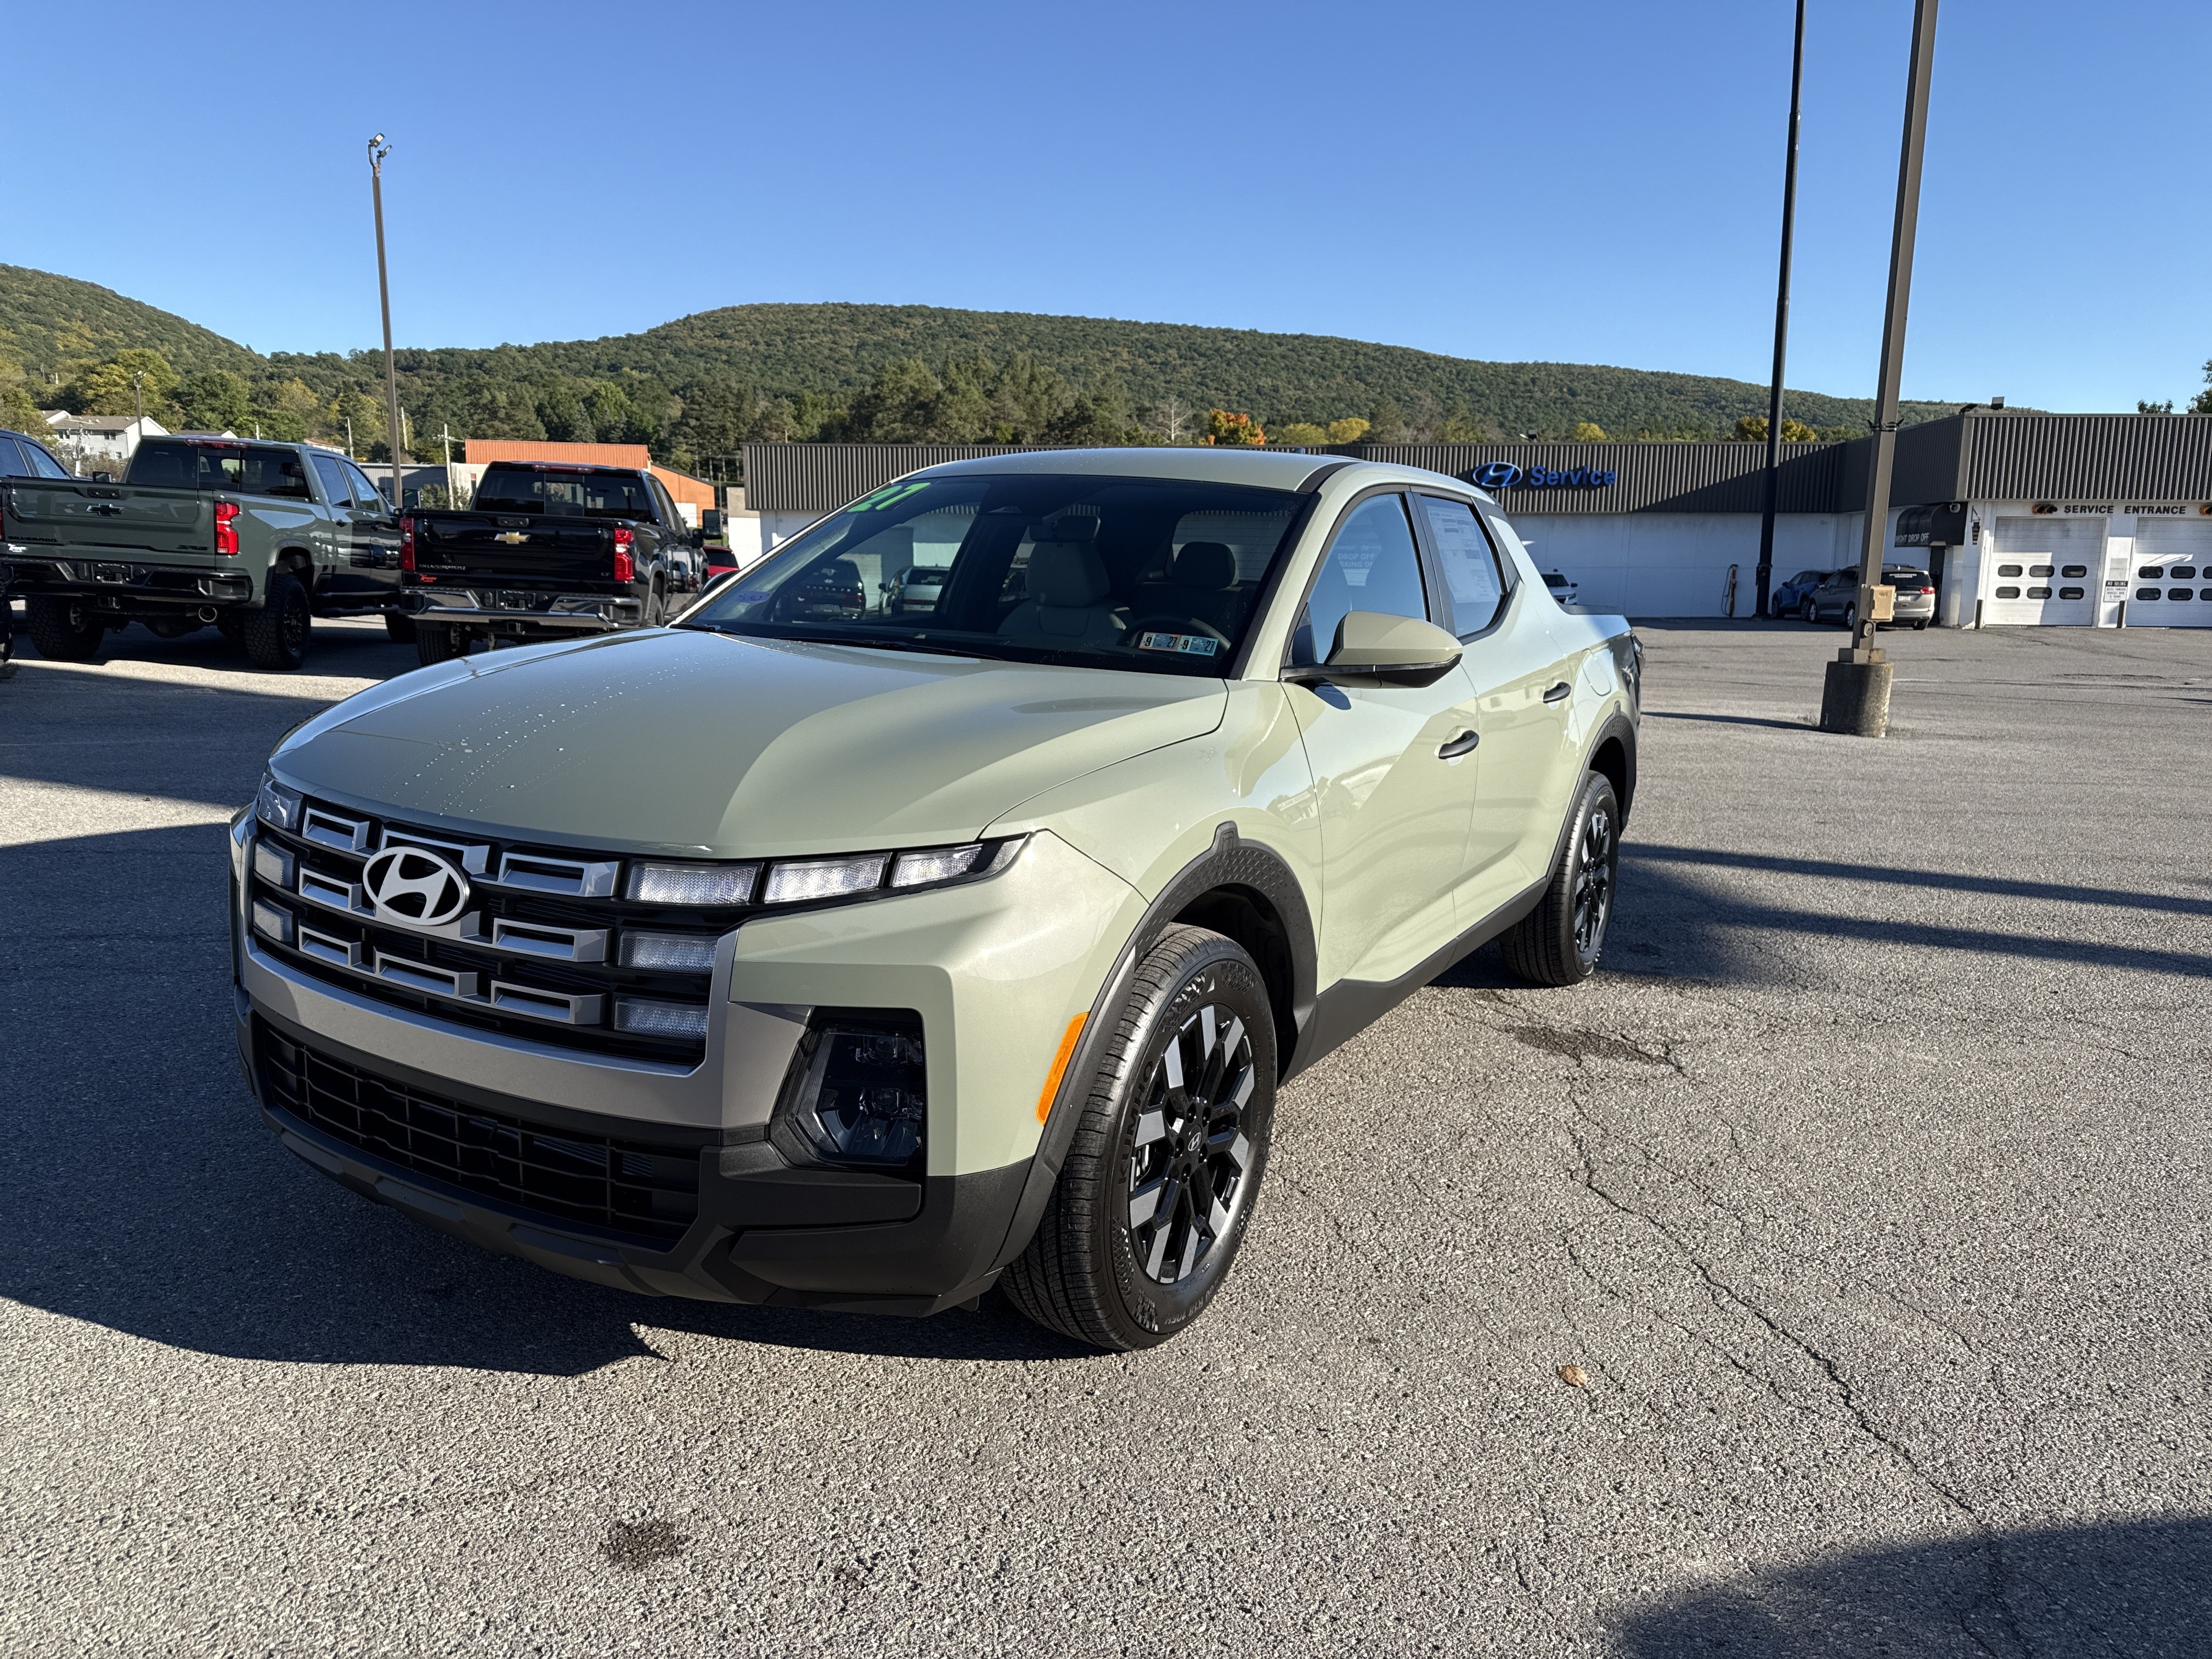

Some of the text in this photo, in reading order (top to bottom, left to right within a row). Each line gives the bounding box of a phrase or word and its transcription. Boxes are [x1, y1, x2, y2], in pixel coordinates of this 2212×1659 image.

[1530, 465, 1616, 486] Service
[2064, 505, 2186, 515] SERVICE ENTRANCE
[1908, 533, 1920, 543] DROP
[1921, 532, 1929, 541] OFF
[1144, 636, 1152, 646] 9
[1166, 636, 1178, 648] 27
[1182, 639, 1189, 650] 9
[1204, 640, 1216, 653] 27
[1118, 1060, 1153, 1185] KUMHO
